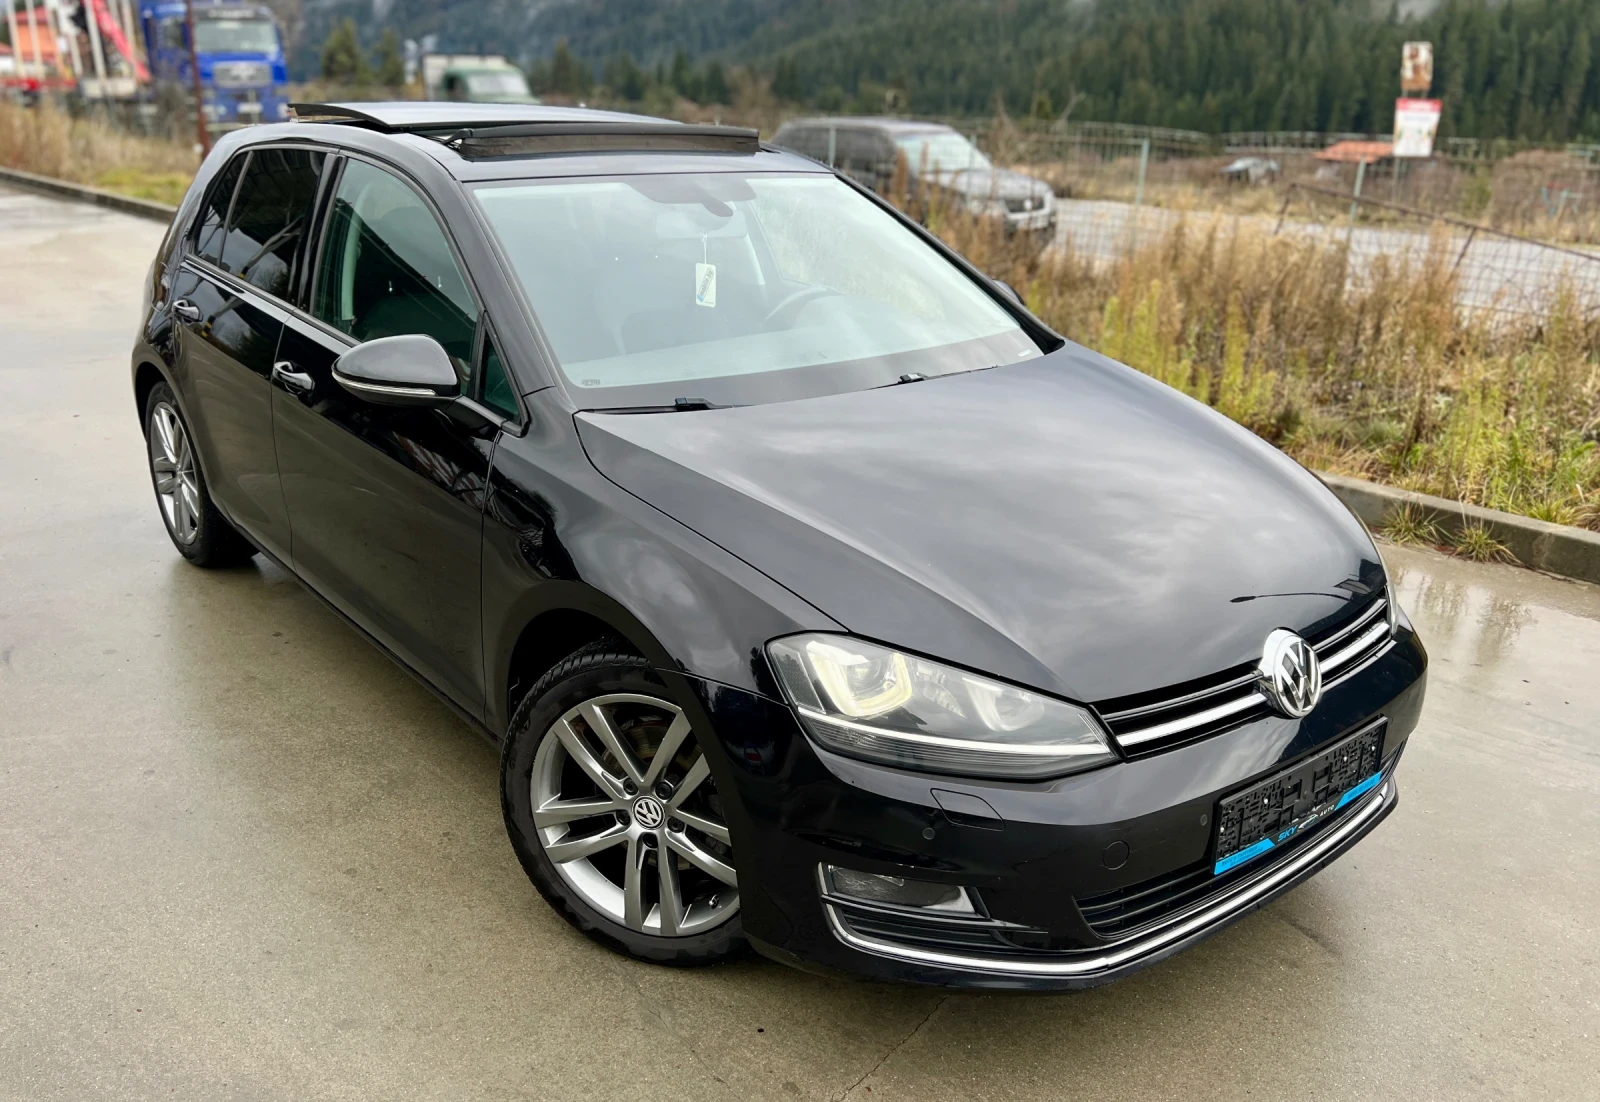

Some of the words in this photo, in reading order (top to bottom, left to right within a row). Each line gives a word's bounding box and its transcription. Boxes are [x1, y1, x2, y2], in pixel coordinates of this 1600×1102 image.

[1274, 635, 1321, 717] VW
[633, 798, 663, 828] VW
[1277, 824, 1298, 842] SKY
[1319, 804, 1335, 817] AUTO
